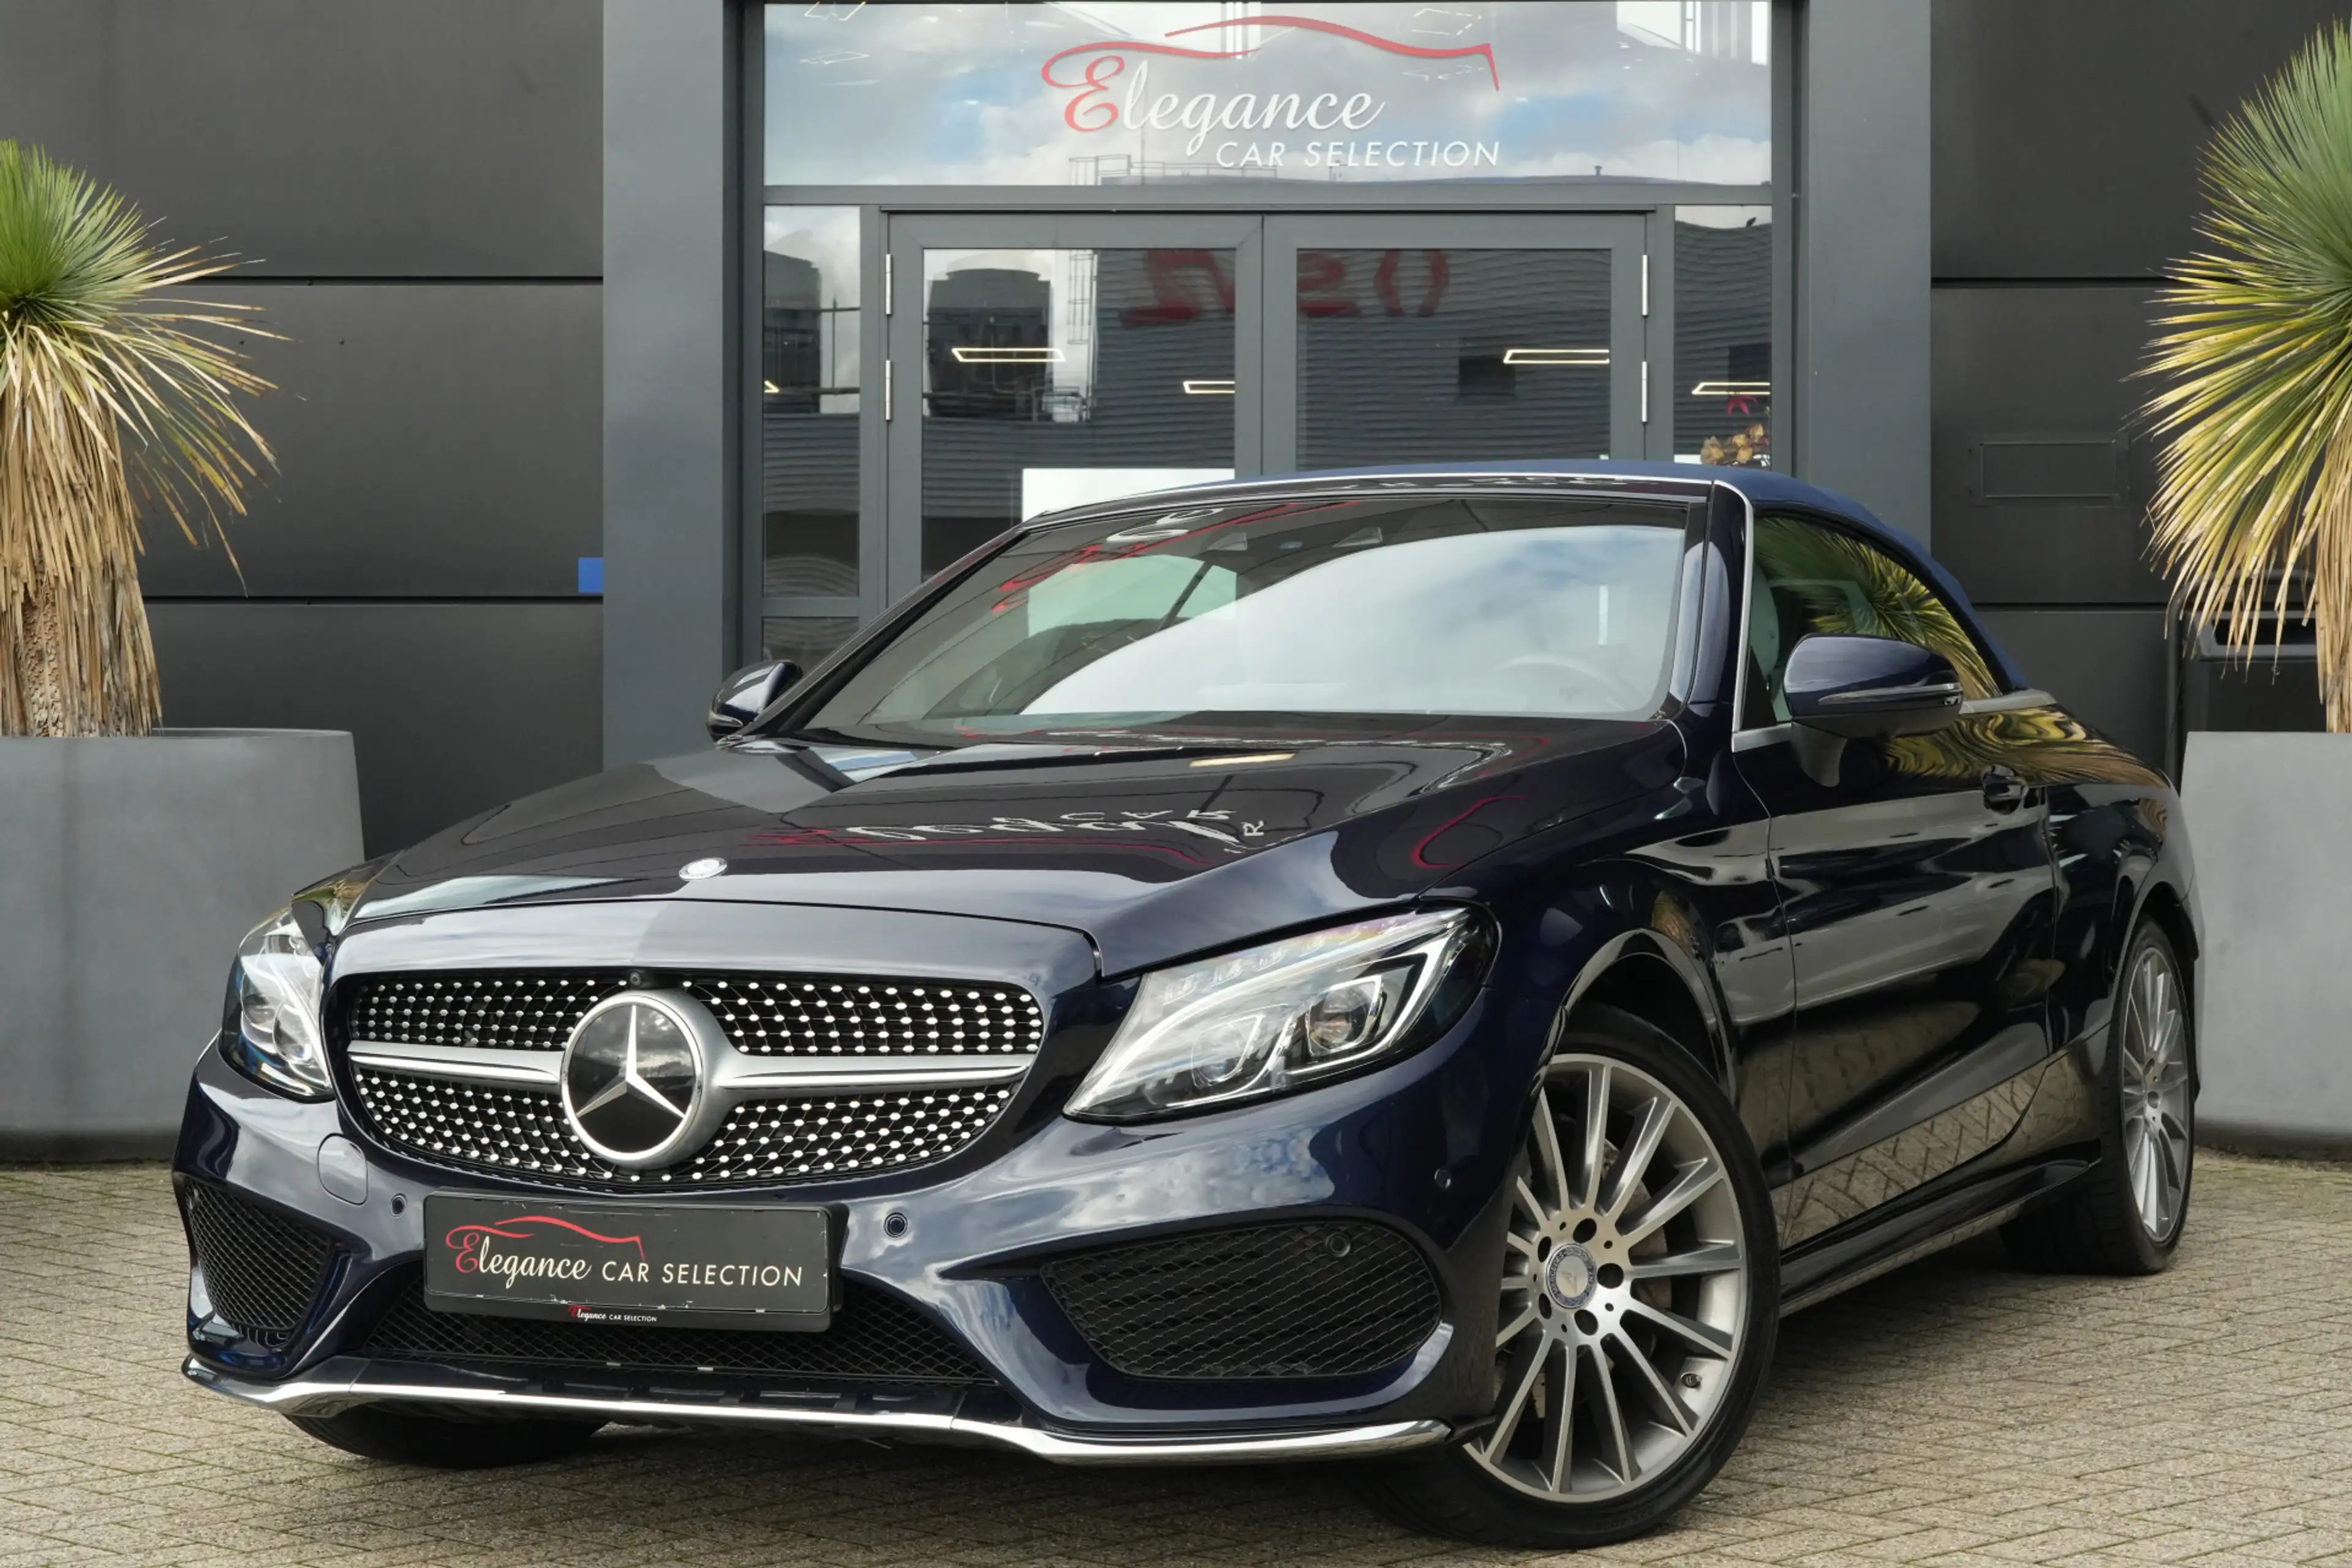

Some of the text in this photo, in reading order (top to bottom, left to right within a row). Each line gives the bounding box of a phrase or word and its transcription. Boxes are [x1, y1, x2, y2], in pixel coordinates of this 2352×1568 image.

[1042, 42, 1385, 157] Elegance
[1216, 141, 1501, 168] CAR SELECTION
[446, 1225, 803, 1288] Elegance CAR SELECTION
